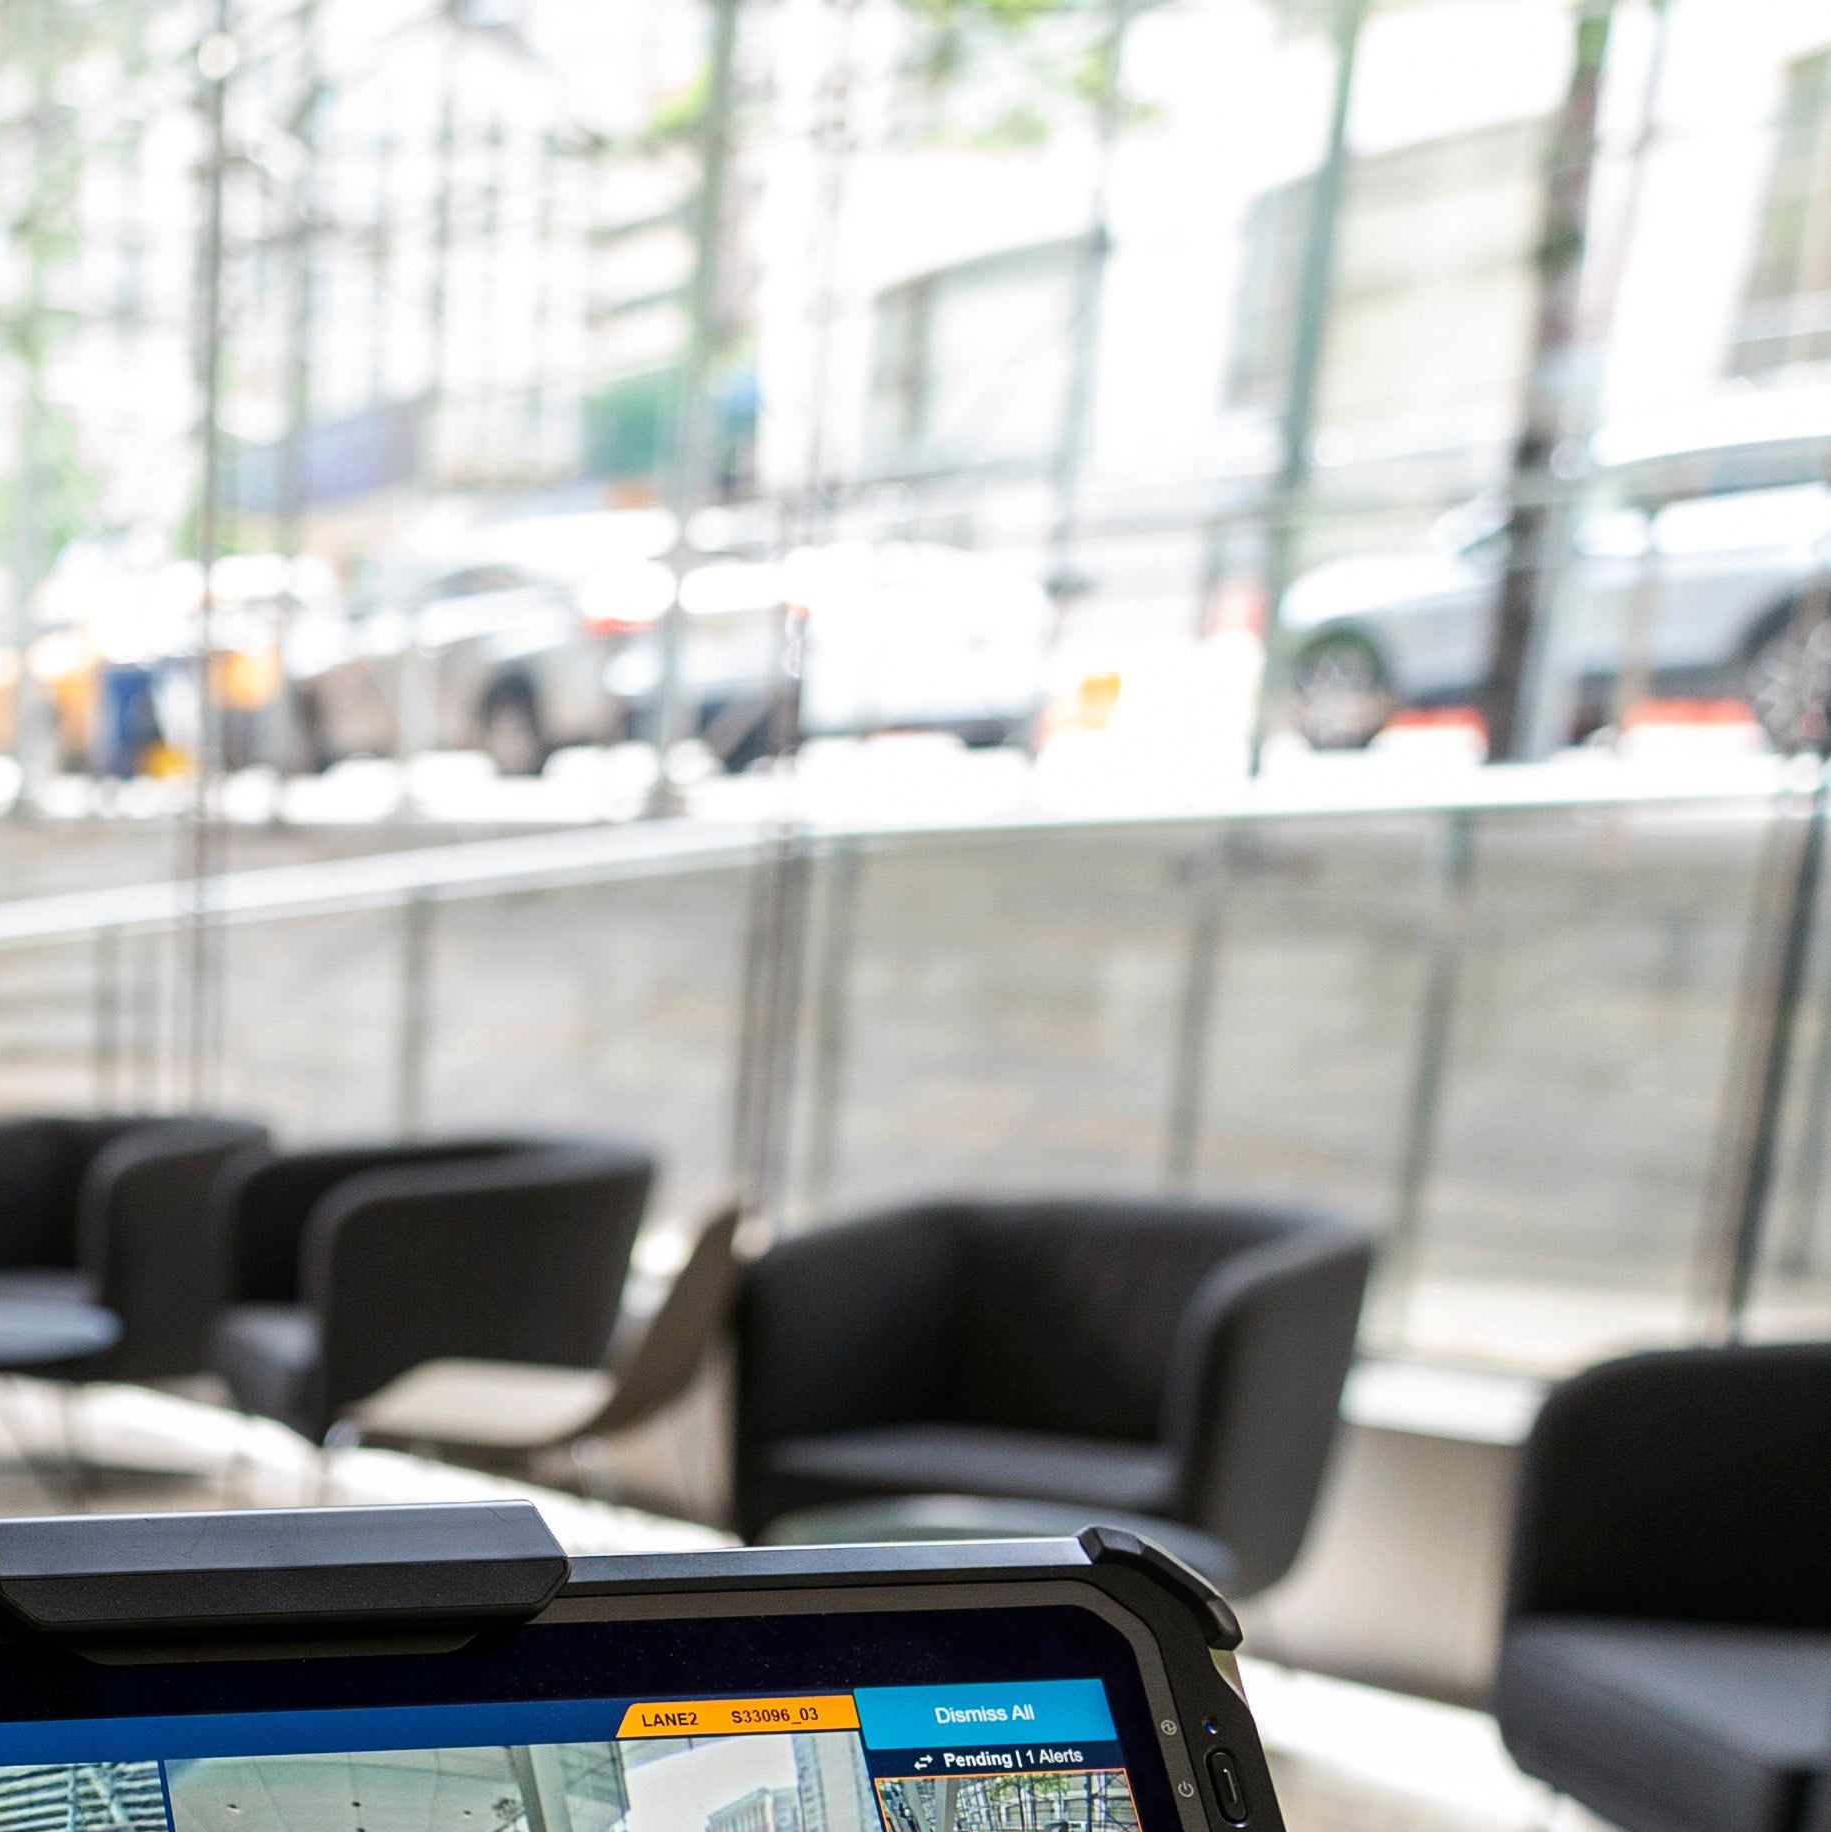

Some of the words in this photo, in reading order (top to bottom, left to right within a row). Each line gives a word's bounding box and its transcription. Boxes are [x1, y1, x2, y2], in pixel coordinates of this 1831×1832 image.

[642, 1712, 699, 1727] LANE2
[731, 1707, 819, 1725] S33096_03
[935, 1706, 1008, 1724] Dismiss
[1012, 1704, 1035, 1721] All
[943, 1751, 1013, 1768] Pending
[1026, 1750, 1035, 1764] 1
[1039, 1749, 1084, 1764] Alerts
